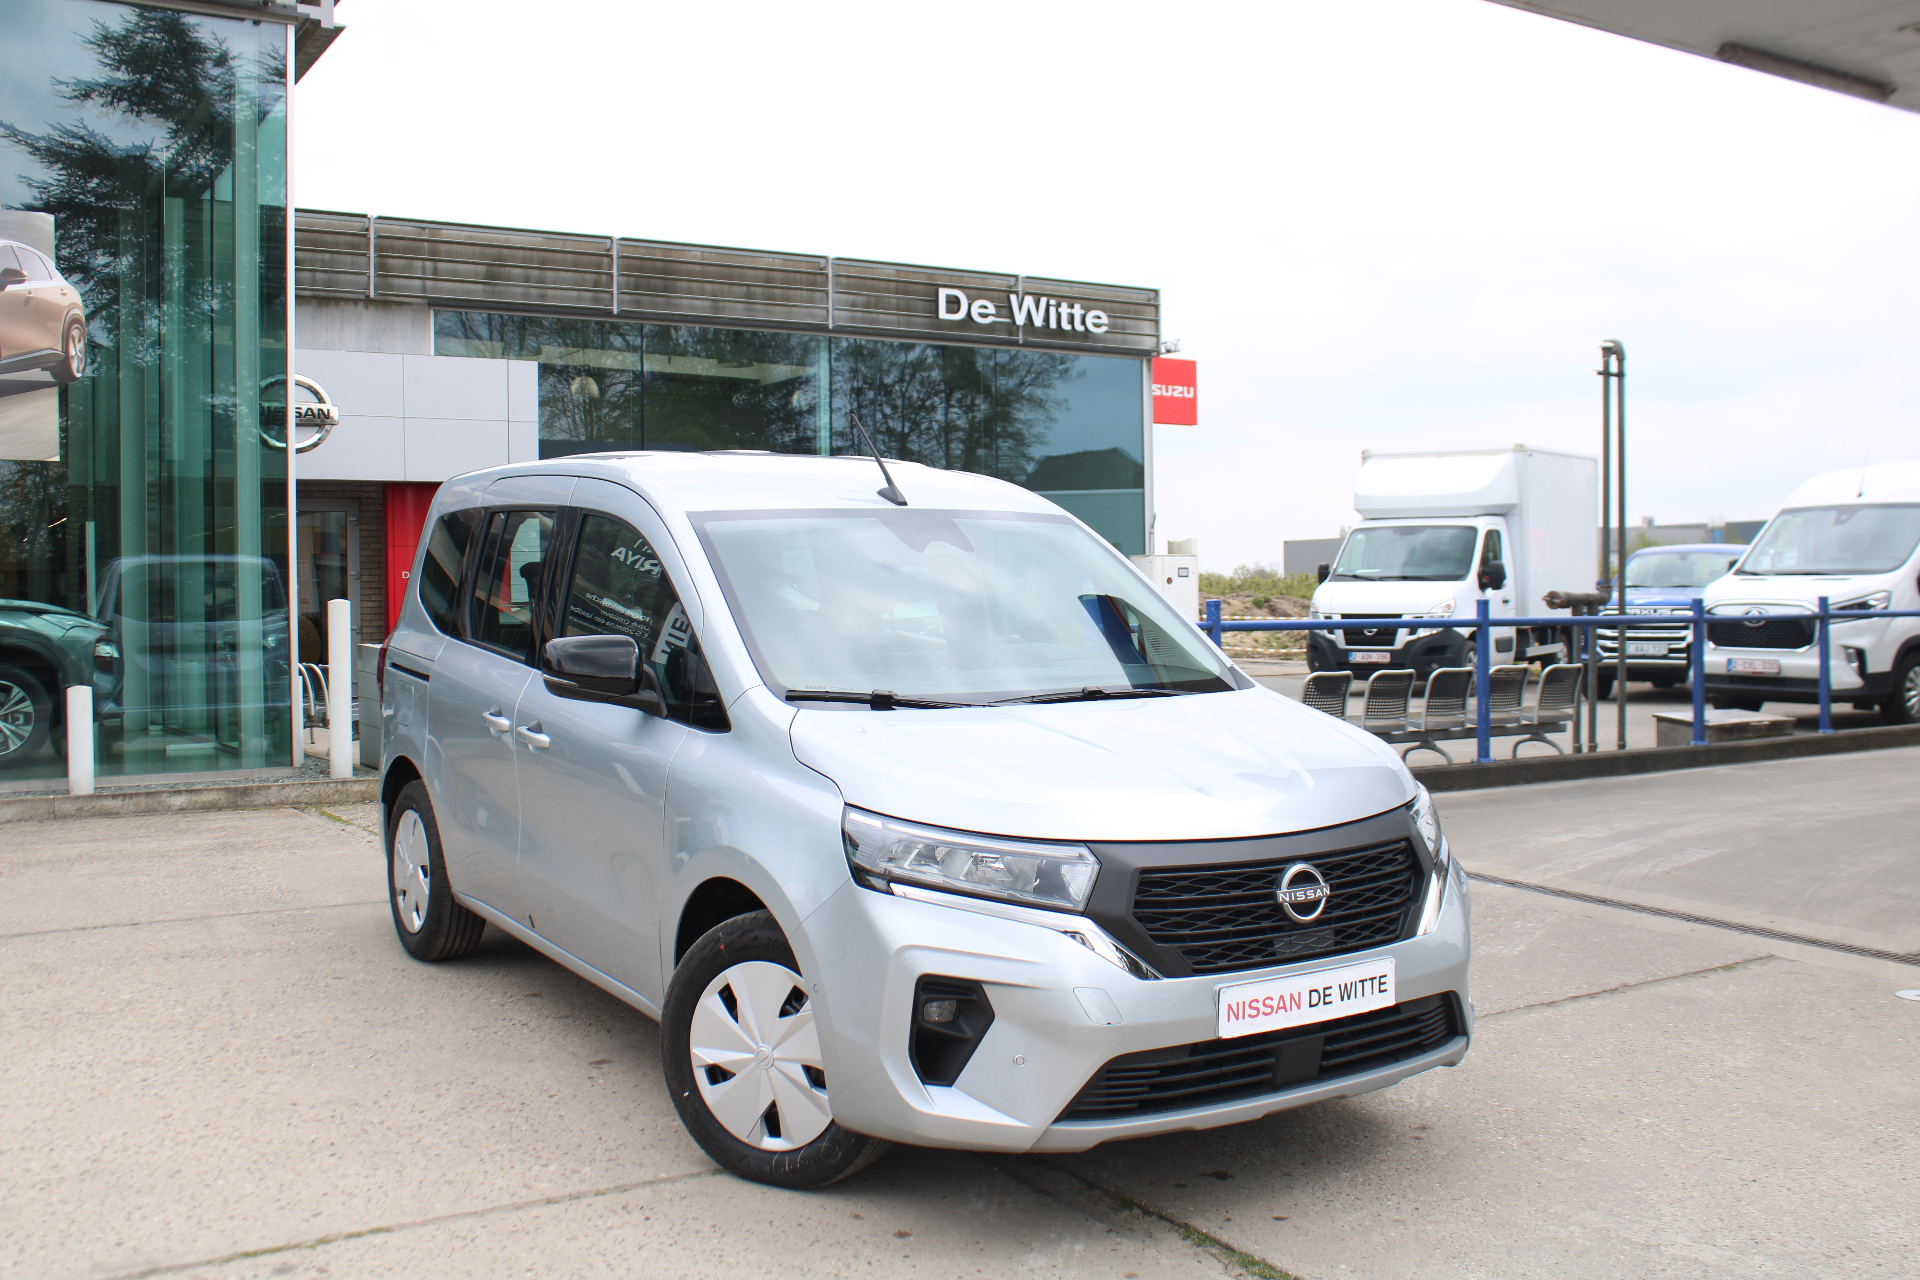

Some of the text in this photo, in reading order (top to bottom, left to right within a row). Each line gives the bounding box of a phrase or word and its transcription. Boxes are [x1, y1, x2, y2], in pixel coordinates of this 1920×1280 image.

[937, 287, 1110, 334] De Witte
[1278, 886, 1330, 903] NISSAN
[1225, 974, 1388, 1024] NISSAN DE WITTE
